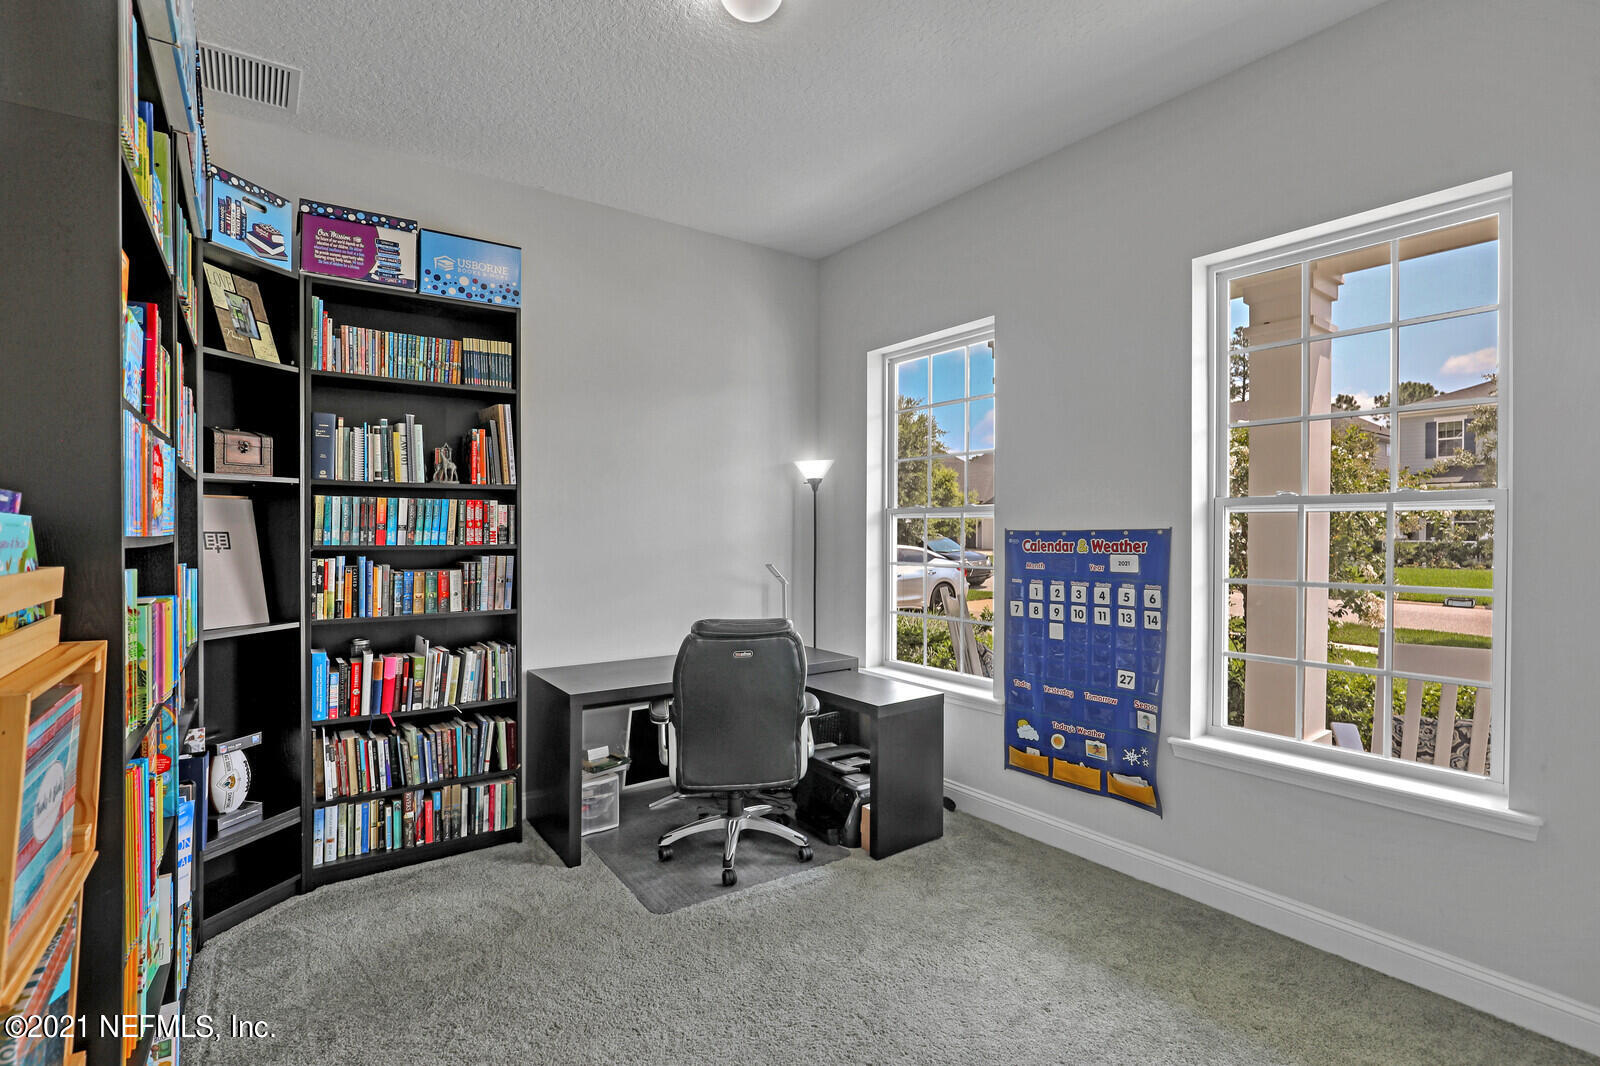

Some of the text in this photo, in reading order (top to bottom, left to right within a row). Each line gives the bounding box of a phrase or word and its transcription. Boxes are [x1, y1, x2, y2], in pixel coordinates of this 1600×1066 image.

[457, 258, 509, 275] USBORNE
[206, 268, 233, 290] LOVE
[1022, 539, 1075, 553] Calendar
[1077, 539, 1089, 553] &
[1091, 538, 1148, 553] Weather
[1026, 562, 1046, 570] Month
[1089, 563, 1105, 572] Year
[1033, 587, 1038, 597] 1
[1054, 588, 1060, 598] 2
[1075, 589, 1082, 599] 3
[1099, 591, 1106, 600] 4
[1123, 592, 1130, 602] 5
[1149, 594, 1156, 604] 6
[1014, 605, 1020, 613] 7
[1033, 606, 1039, 615] 8
[1054, 607, 1060, 617] 9
[1074, 609, 1084, 620] 10
[1098, 611, 1107, 621] 11
[1121, 613, 1133, 624] 13
[1146, 615, 1158, 626] 14
[1013, 679, 1032, 690] Today
[1119, 674, 1134, 685] 27
[1043, 685, 1075, 699] Yesterday
[1084, 691, 1119, 706] Tomorrow
[1052, 721, 1106, 739] Today's Weather
